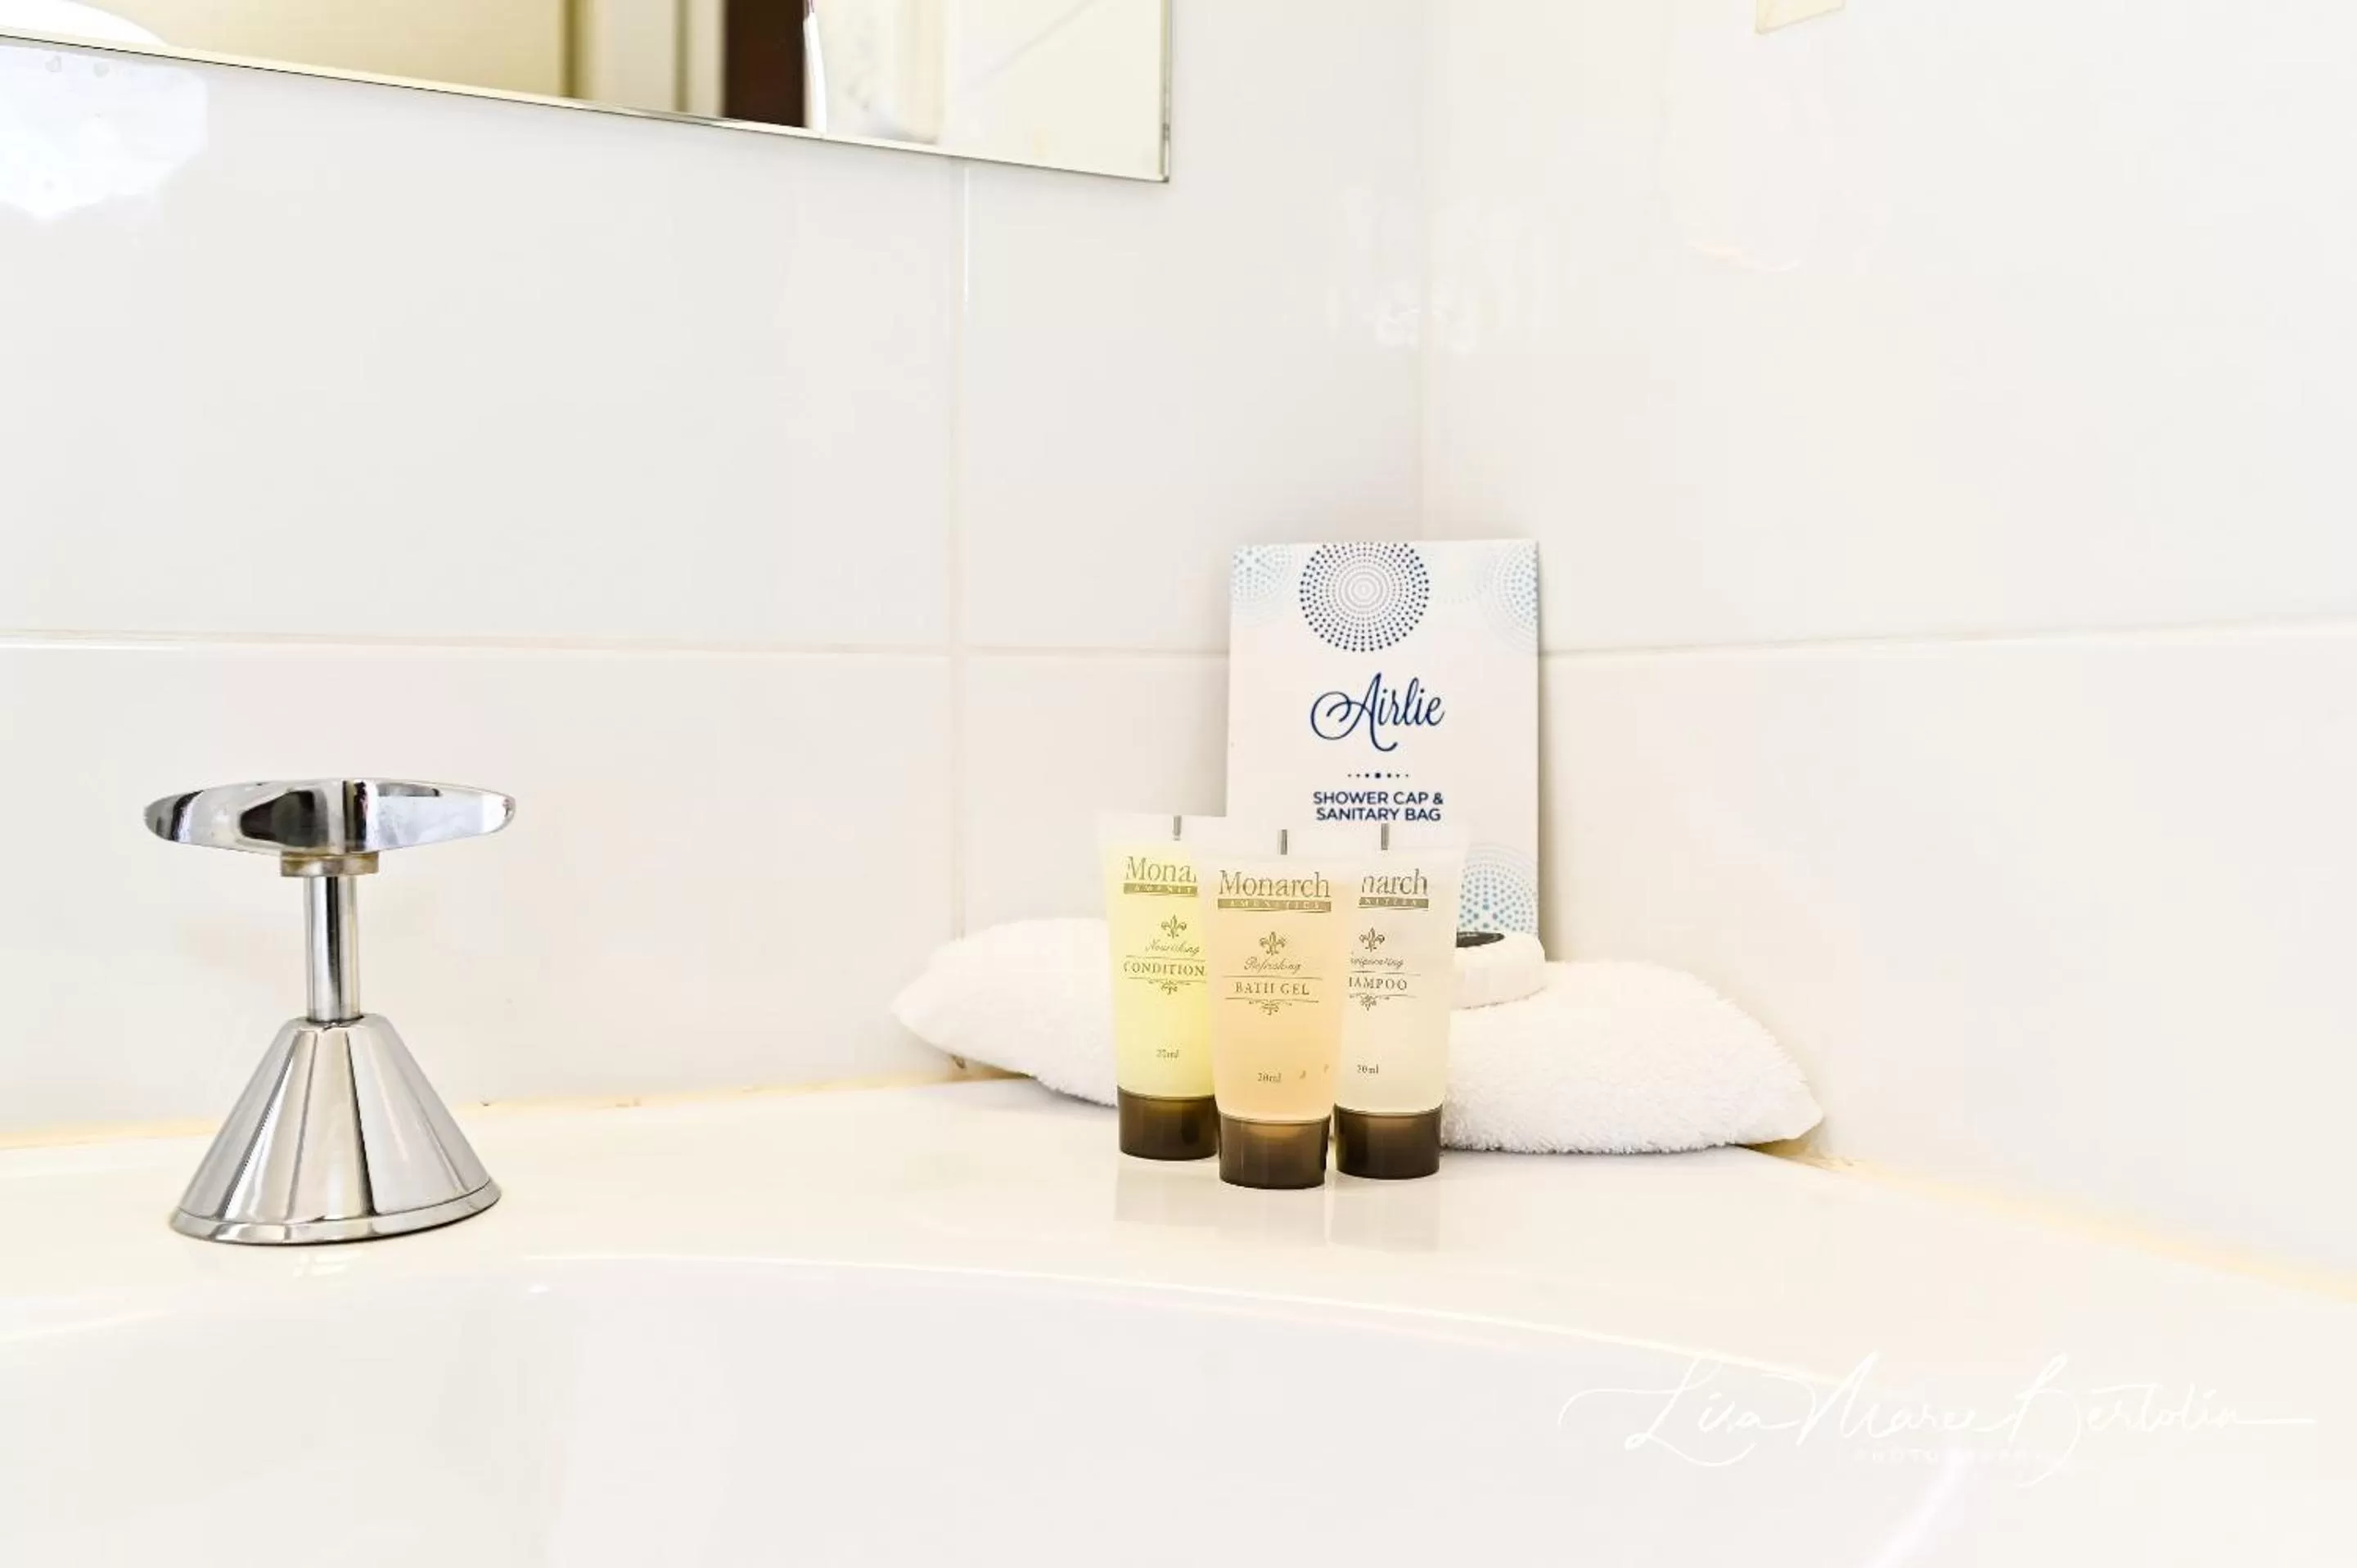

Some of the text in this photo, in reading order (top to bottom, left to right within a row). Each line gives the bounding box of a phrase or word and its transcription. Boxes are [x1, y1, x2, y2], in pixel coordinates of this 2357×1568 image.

[1310, 672, 1445, 751] Airlie
[1313, 791, 1444, 804] SHOWER CAP &
[1316, 807, 1441, 821] SANITARY BAG
[1218, 869, 1332, 898] Monarch
[1360, 867, 1428, 895] narch
[1123, 960, 1206, 976] CONDITION
[1233, 981, 1310, 996] BATH GEL
